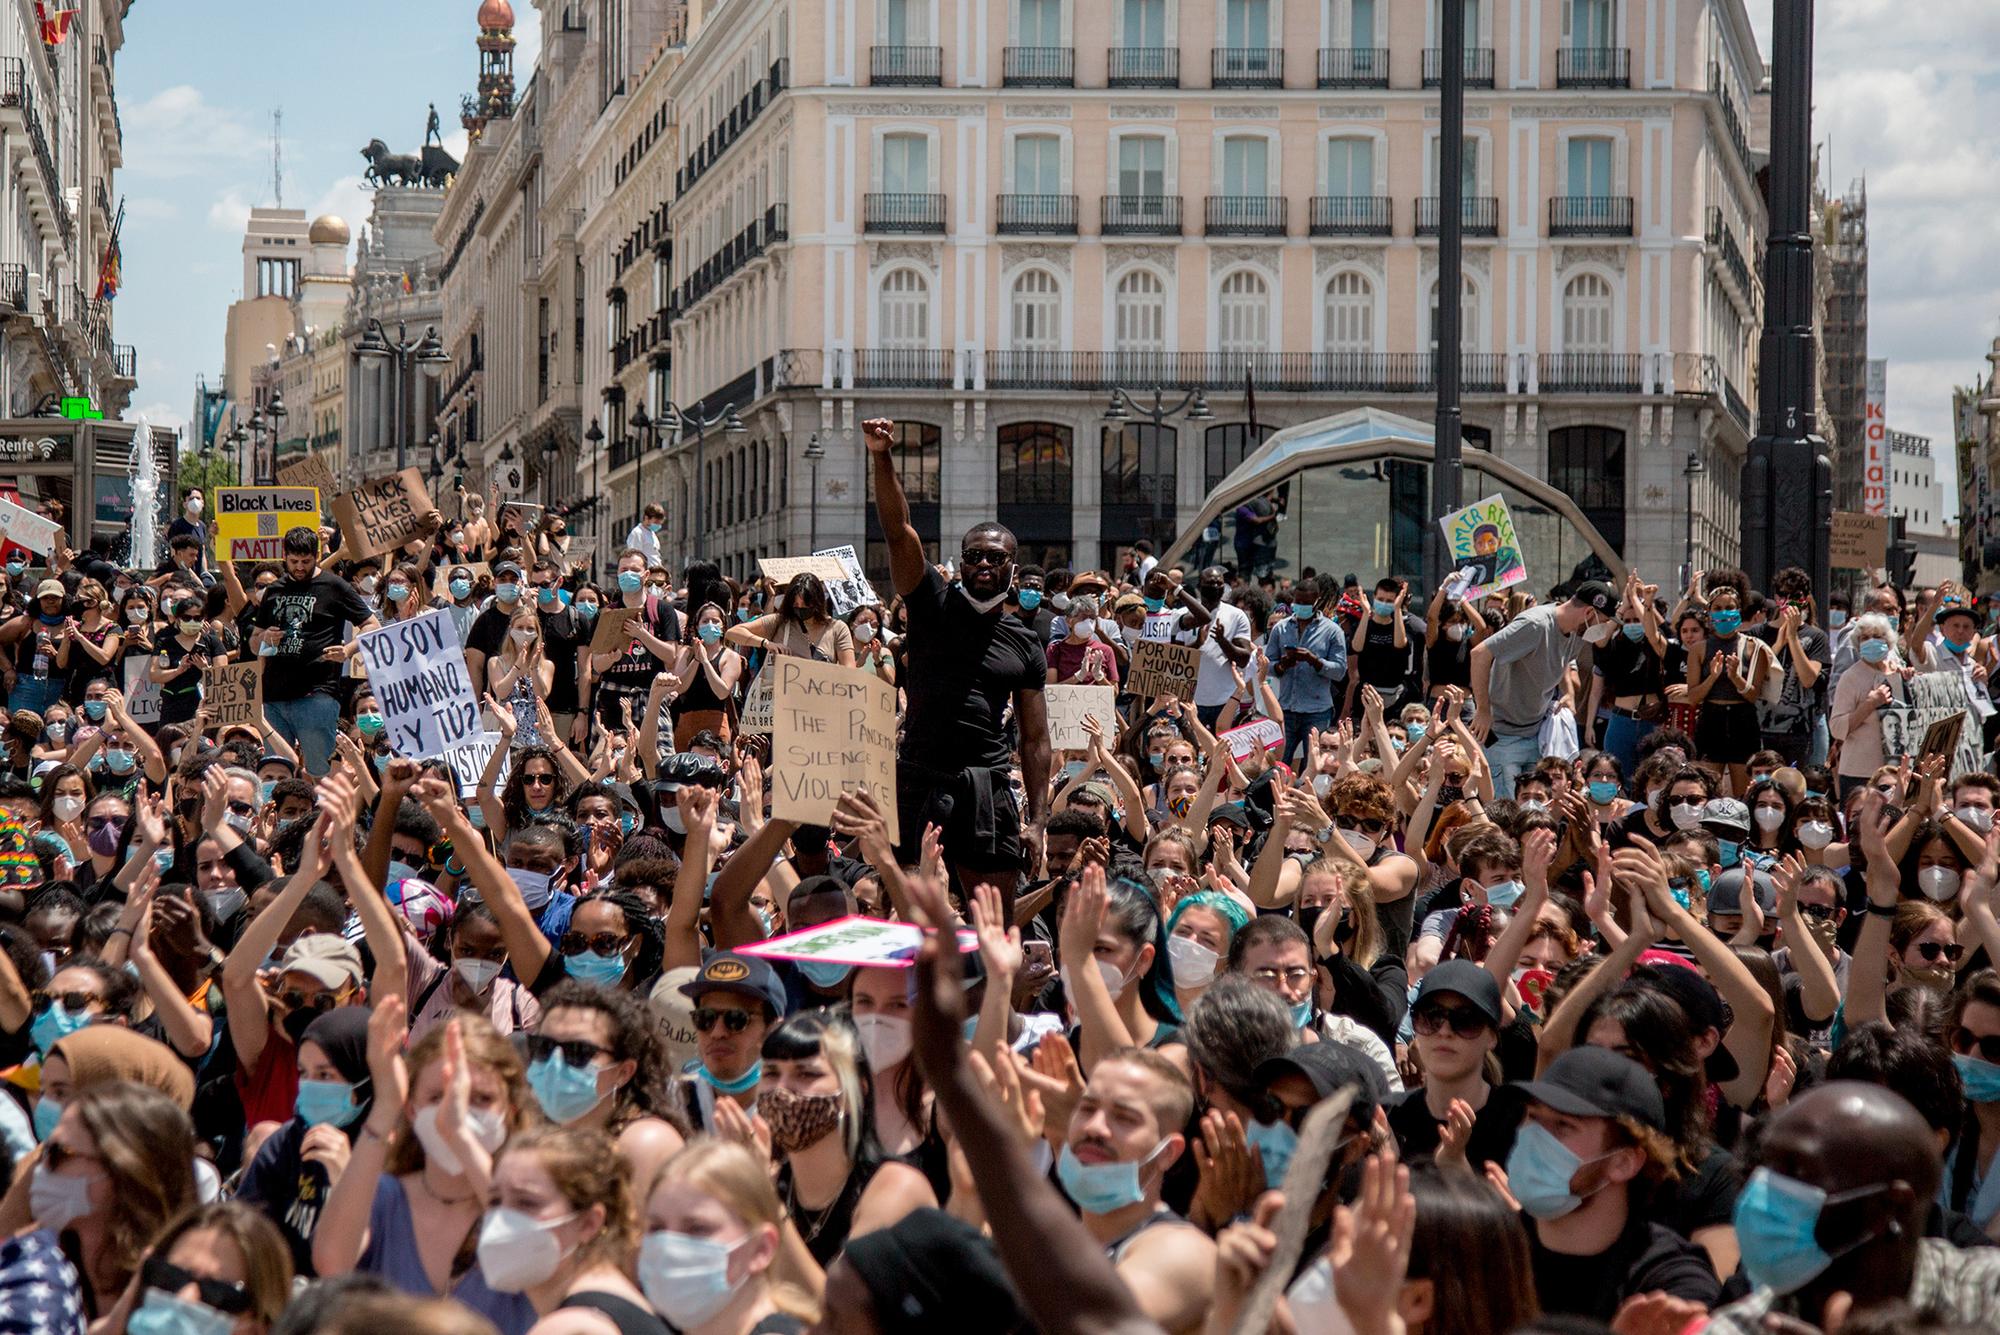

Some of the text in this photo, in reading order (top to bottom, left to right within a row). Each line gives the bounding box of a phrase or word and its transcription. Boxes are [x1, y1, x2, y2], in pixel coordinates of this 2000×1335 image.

[222, 494, 312, 512] Black Lives
[351, 477, 408, 512] BLACK
[360, 498, 411, 529] LIVES
[1488, 503, 1514, 544] RICE
[366, 514, 422, 547] MATTER
[232, 538, 286, 559] MATT
[361, 634, 394, 669] YO
[400, 616, 444, 662] SOY
[1136, 641, 1191, 664] POR UN
[205, 666, 240, 687] BLACK
[1142, 658, 1195, 679] MUNDO
[205, 685, 236, 704] LIVES
[380, 662, 466, 718] HUMANO.
[783, 663, 892, 713] RACISM IS
[1045, 688, 1109, 705] BLACK
[783, 707, 827, 733] THE
[788, 745, 871, 767] SILENCE
